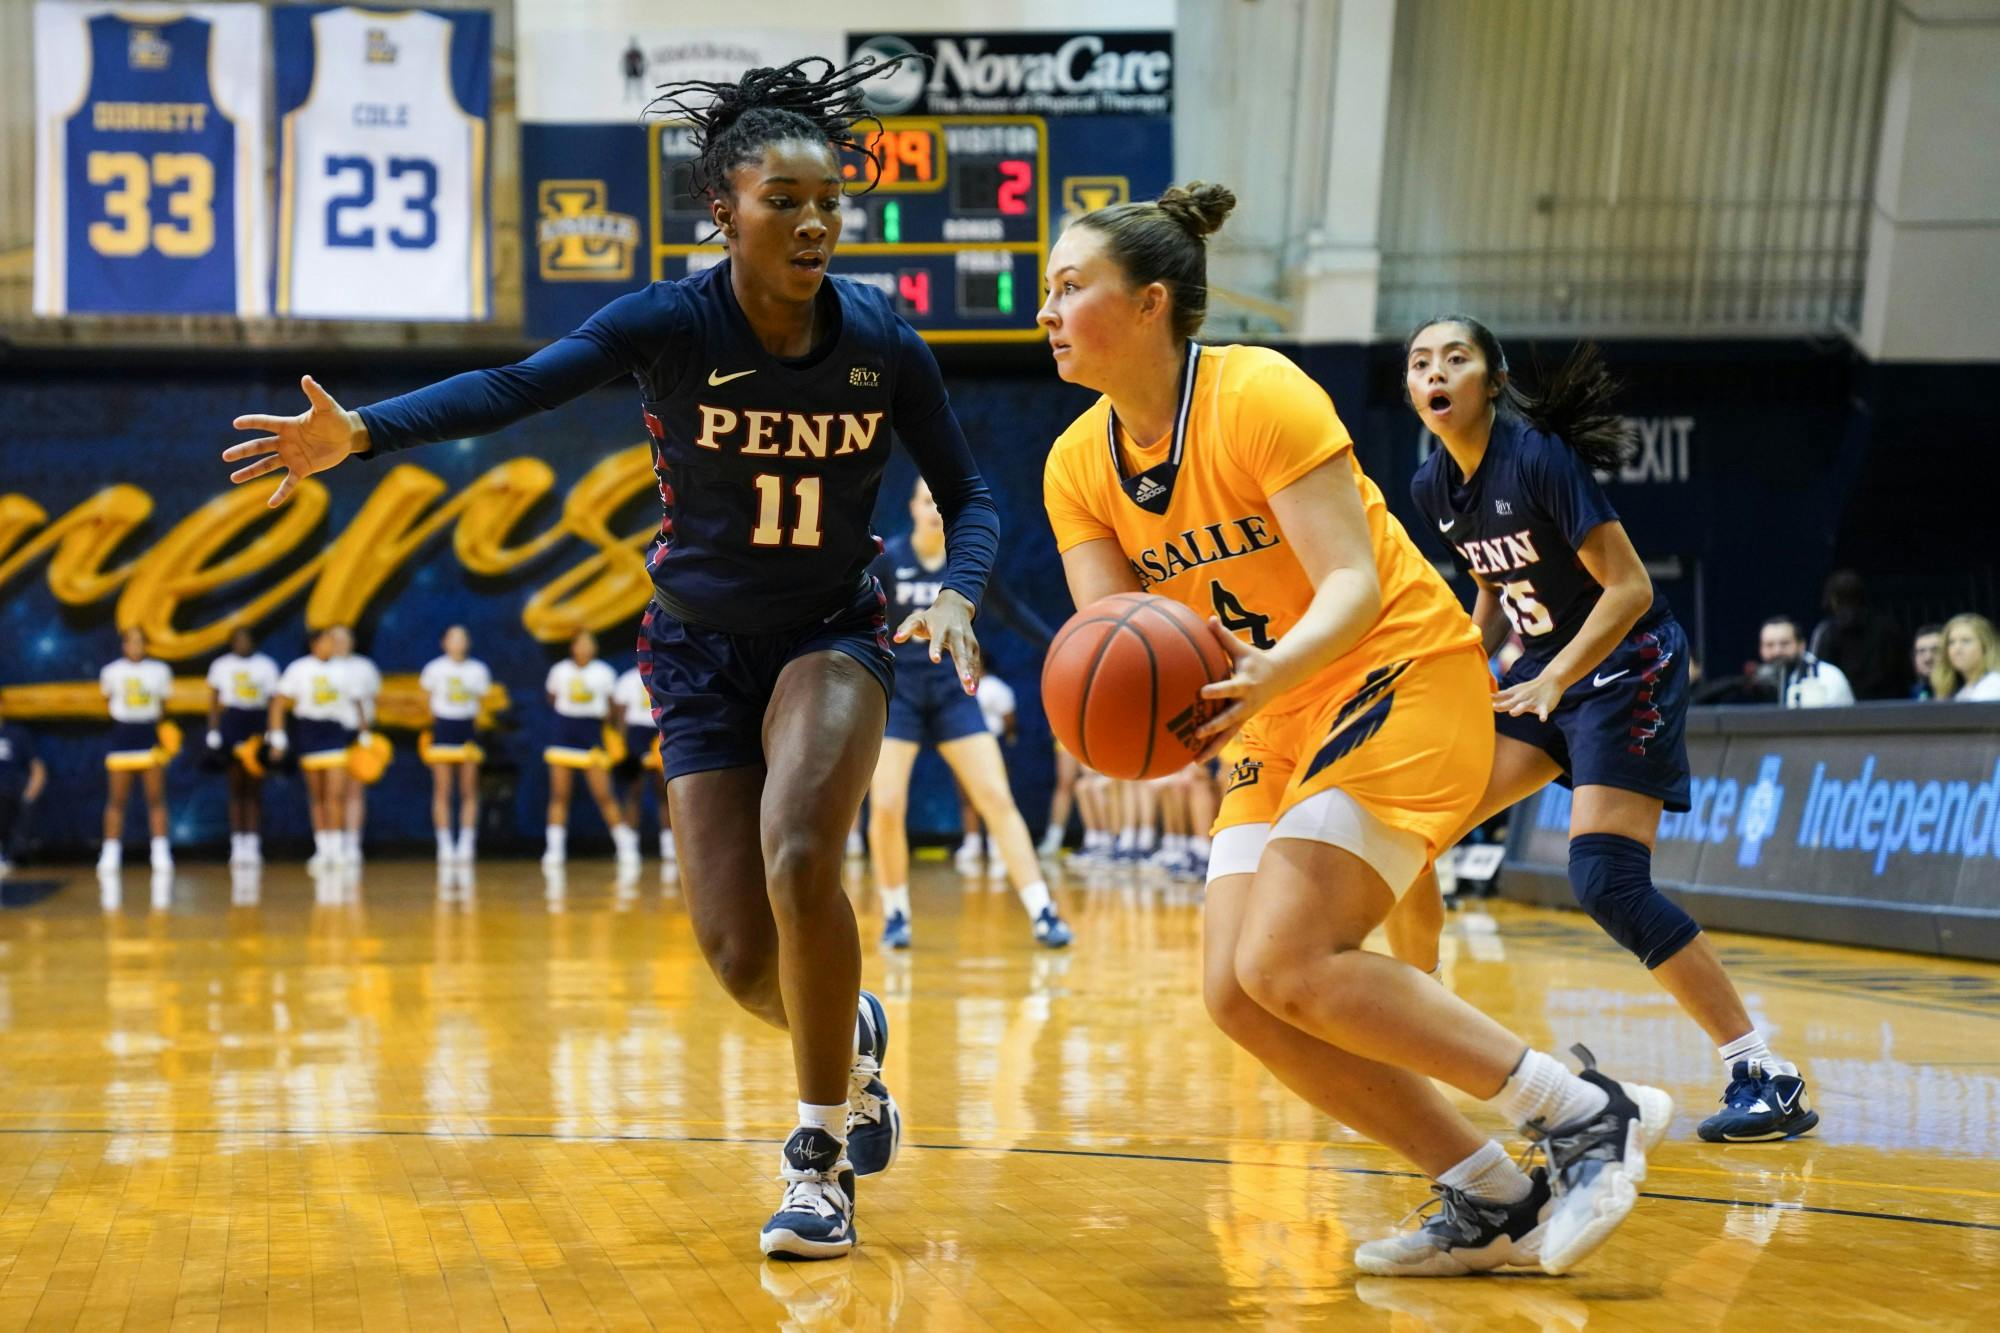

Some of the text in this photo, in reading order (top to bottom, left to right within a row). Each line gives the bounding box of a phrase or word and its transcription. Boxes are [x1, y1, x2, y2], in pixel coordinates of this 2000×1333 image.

[930, 37, 1170, 94] NovaCare
[88, 152, 214, 257] 33
[325, 155, 439, 250] 23
[998, 161, 1032, 214] 2
[884, 201, 900, 243] 1
[899, 272, 929, 314] 4
[998, 271, 1014, 314] 1
[857, 371, 880, 381] IVY
[695, 404, 884, 459] PENN
[1620, 416, 1695, 483] EXIT
[752, 473, 822, 547] 11
[1136, 485, 1167, 503] adidas
[1131, 515, 1281, 592] ASALLE
[1209, 579, 1277, 650] 4
[1494, 580, 1554, 637] 15
[1797, 754, 2000, 877] Independ
